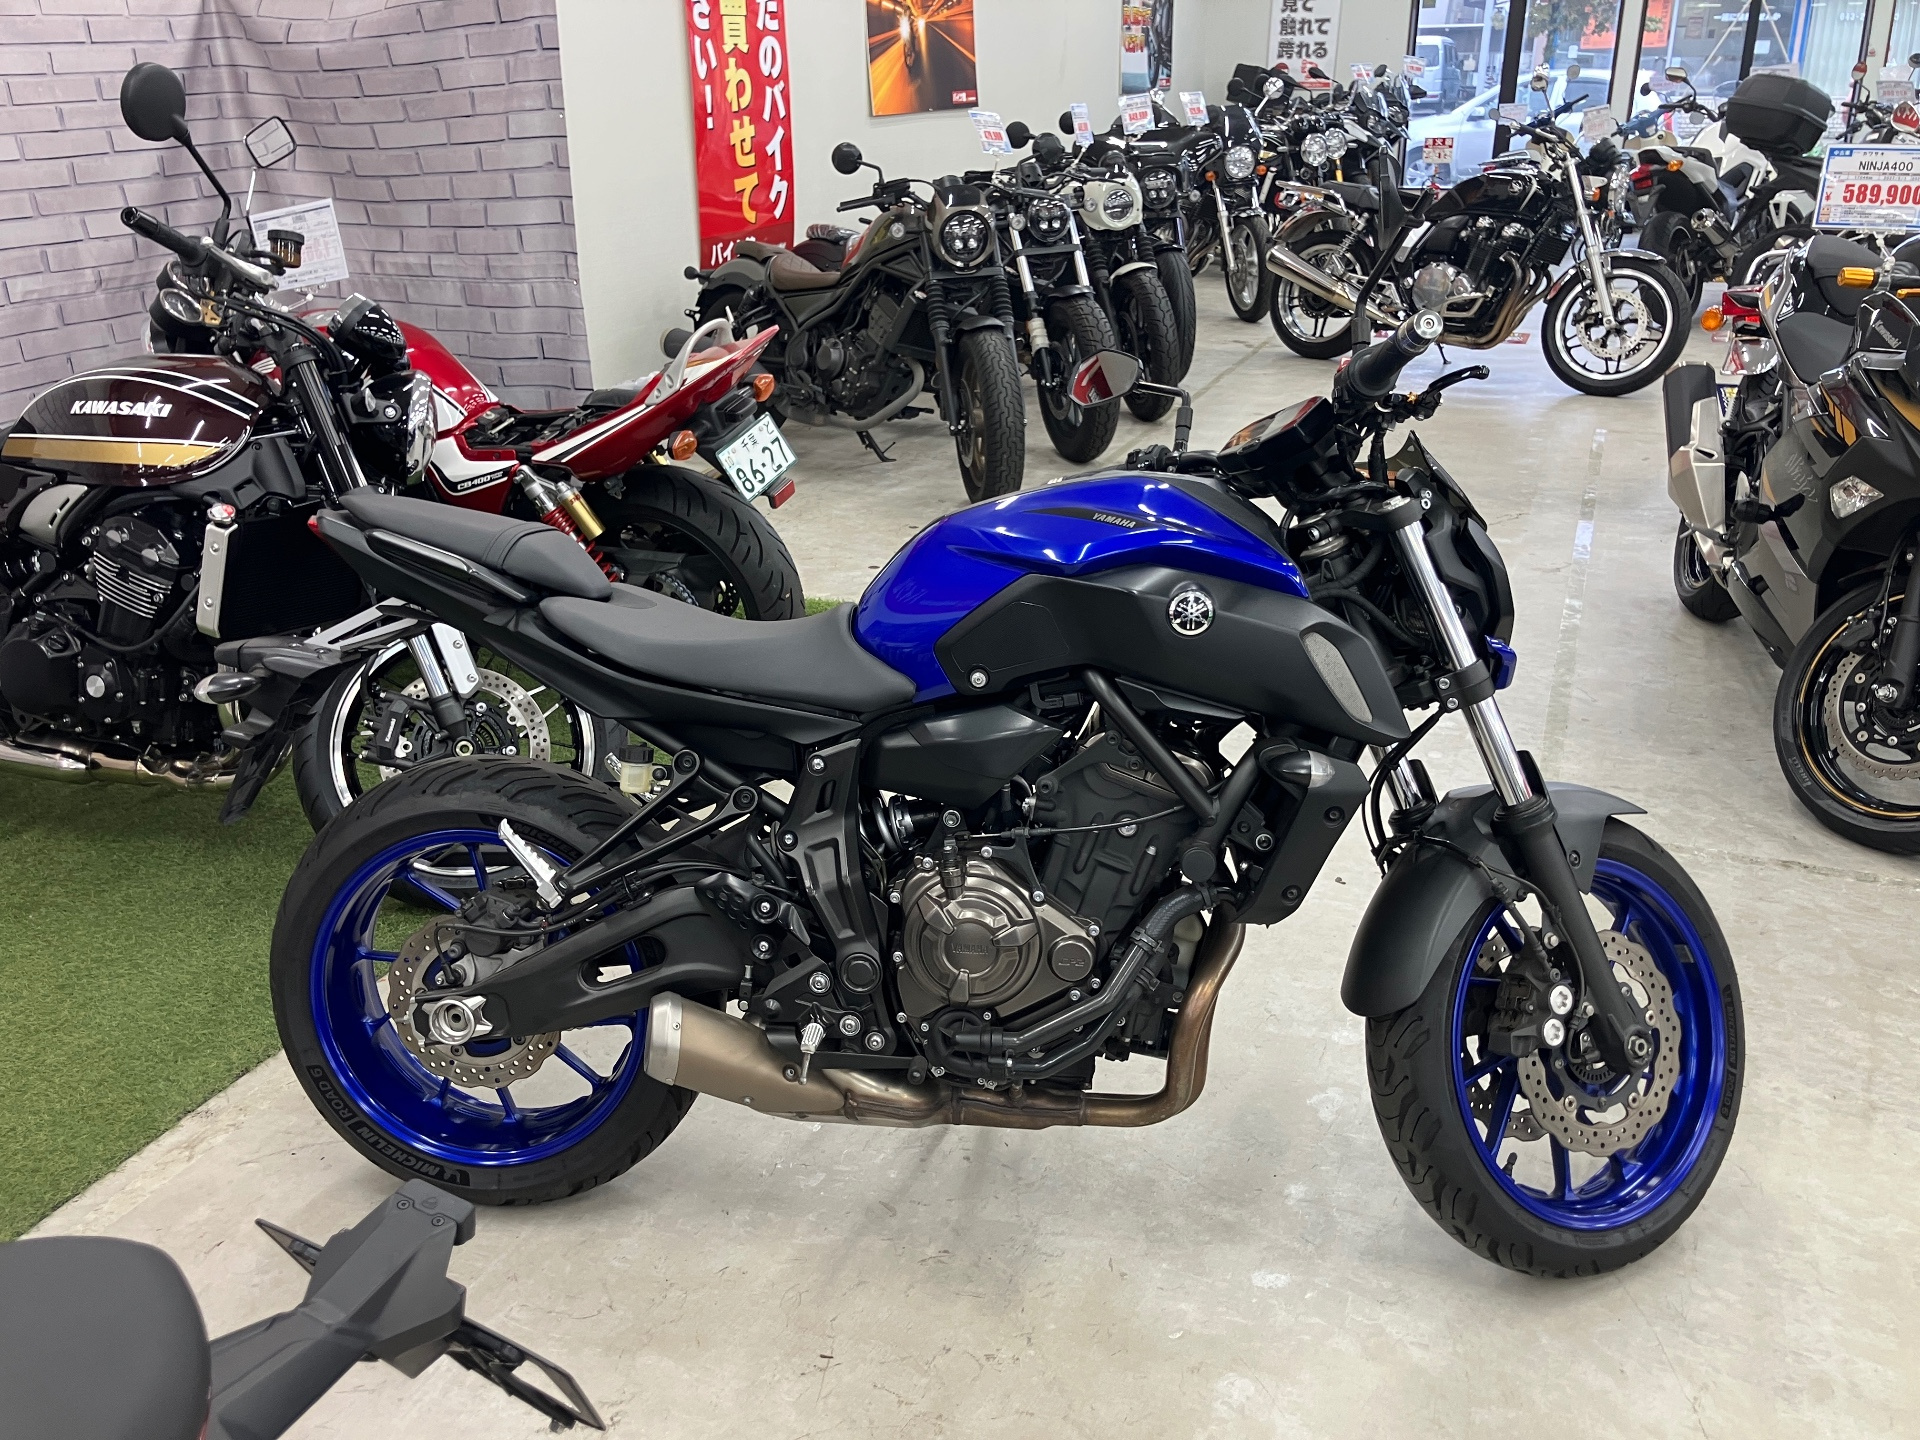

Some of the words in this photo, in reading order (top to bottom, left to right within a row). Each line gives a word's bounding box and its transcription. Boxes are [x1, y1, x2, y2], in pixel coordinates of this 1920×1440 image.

[1858, 160, 1914, 172] NINJA400
[1843, 184, 1920, 206] 589,900
[1873, 319, 1902, 349] Kawasaki
[70, 400, 173, 418] KAWASAKI
[457, 475, 491, 490] CB400
[1092, 512, 1136, 529] YAMAHA
[318, 1081, 352, 1120] ROAD
[355, 1125, 441, 1178] MICHELIN
